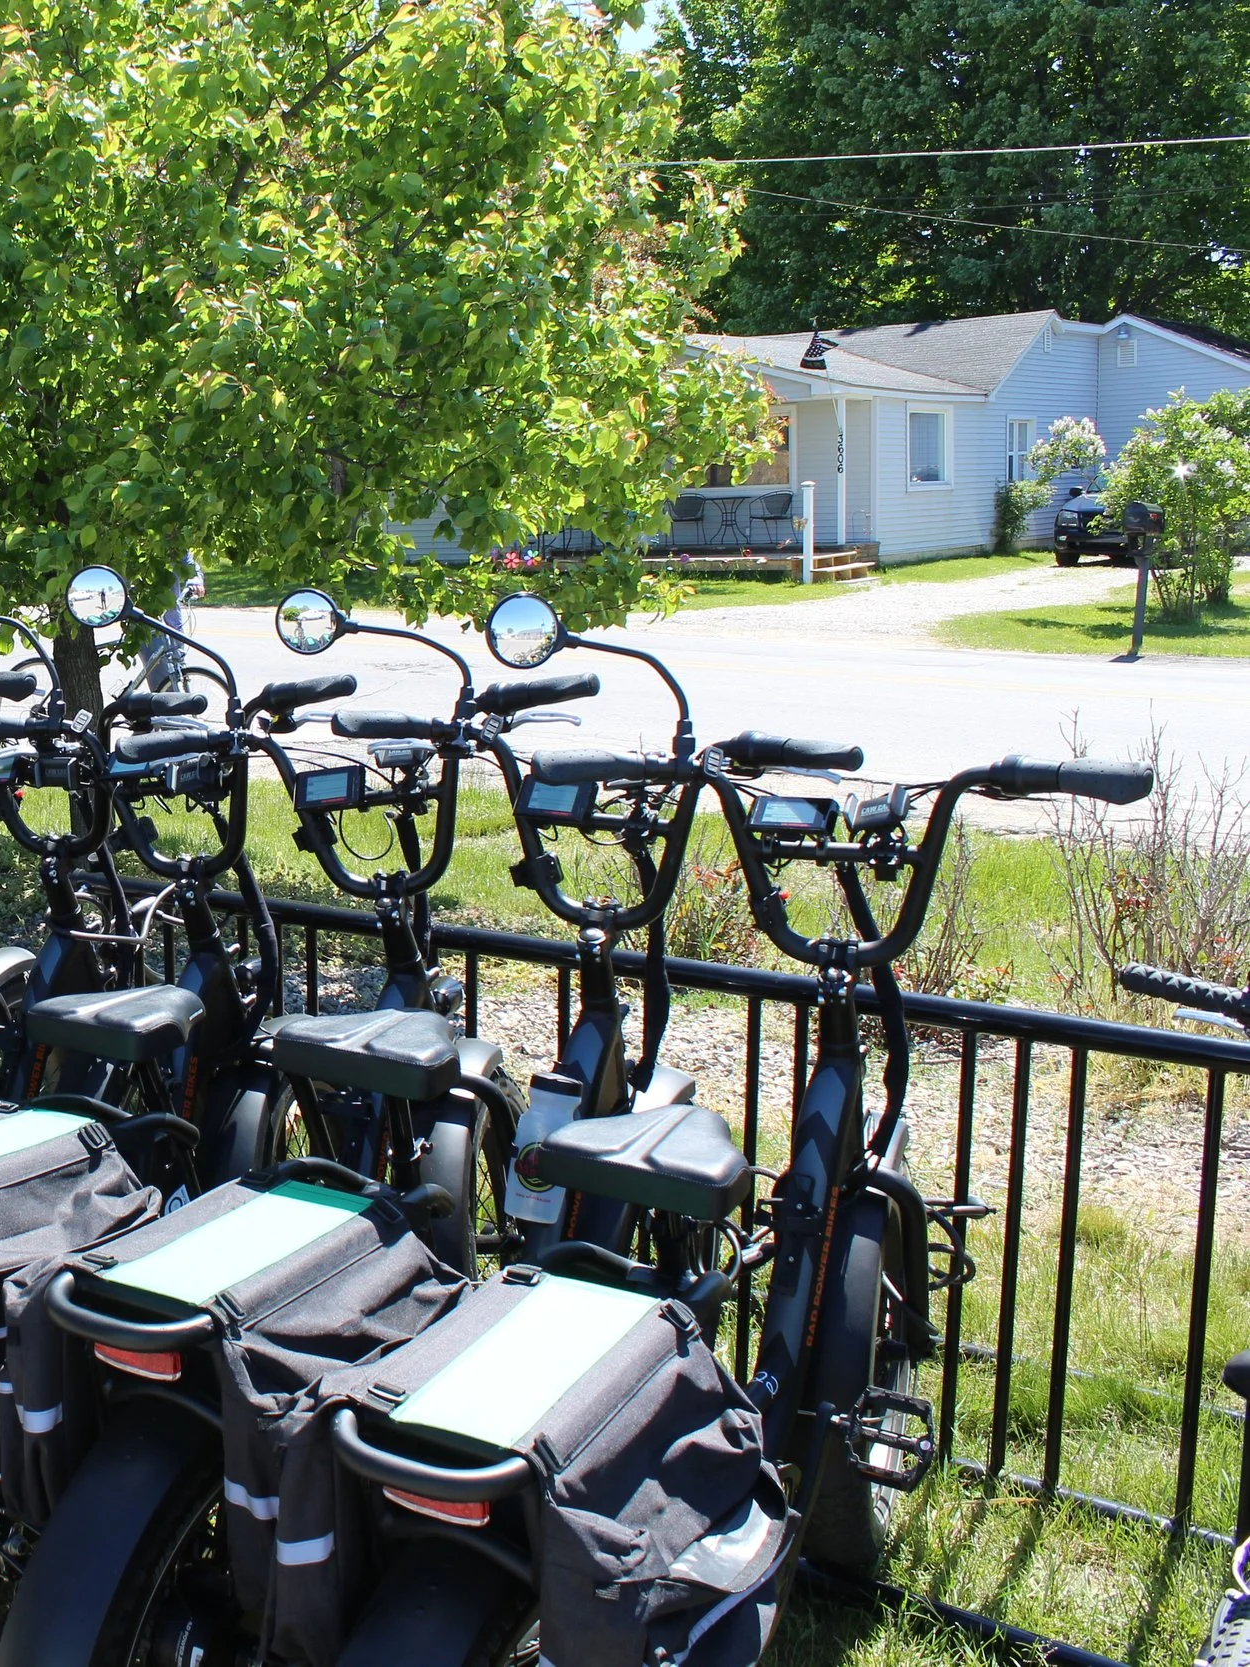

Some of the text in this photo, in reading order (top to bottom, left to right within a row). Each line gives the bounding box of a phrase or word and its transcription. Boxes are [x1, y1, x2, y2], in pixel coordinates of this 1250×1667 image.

[805, 1185, 840, 1347] RAD POWER BIKES
